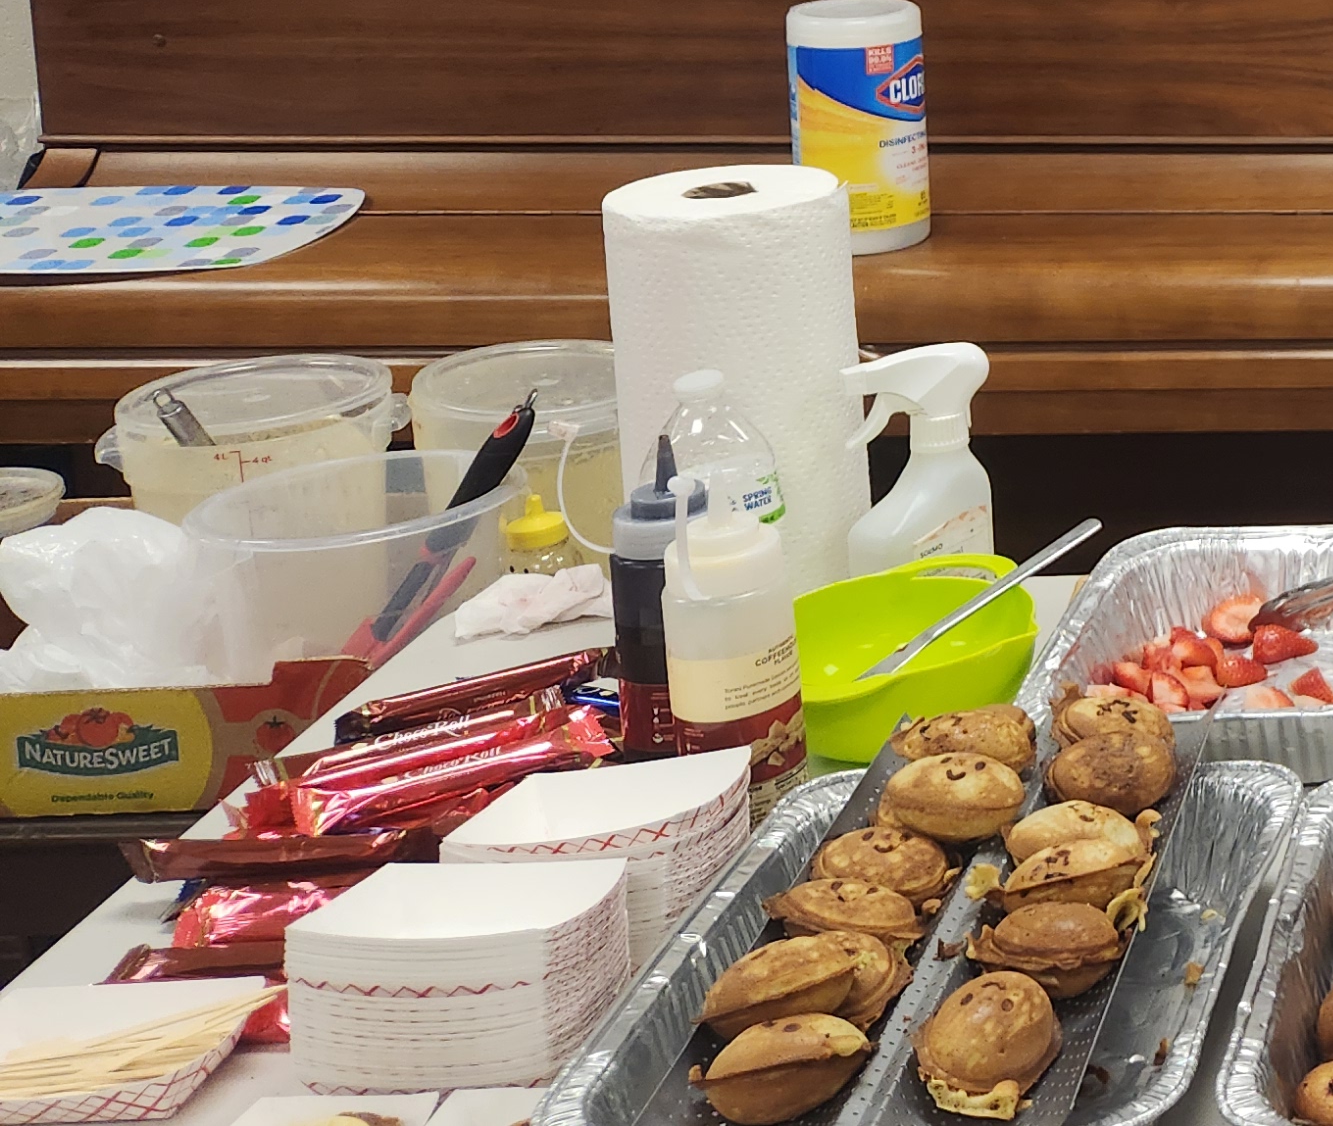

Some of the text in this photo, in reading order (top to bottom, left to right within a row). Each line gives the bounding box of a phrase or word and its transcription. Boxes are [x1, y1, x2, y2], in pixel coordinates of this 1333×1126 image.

[743, 487, 772, 503] SPRING
[744, 496, 772, 511] WATER
[52, 790, 153, 803] Dependable Quality
